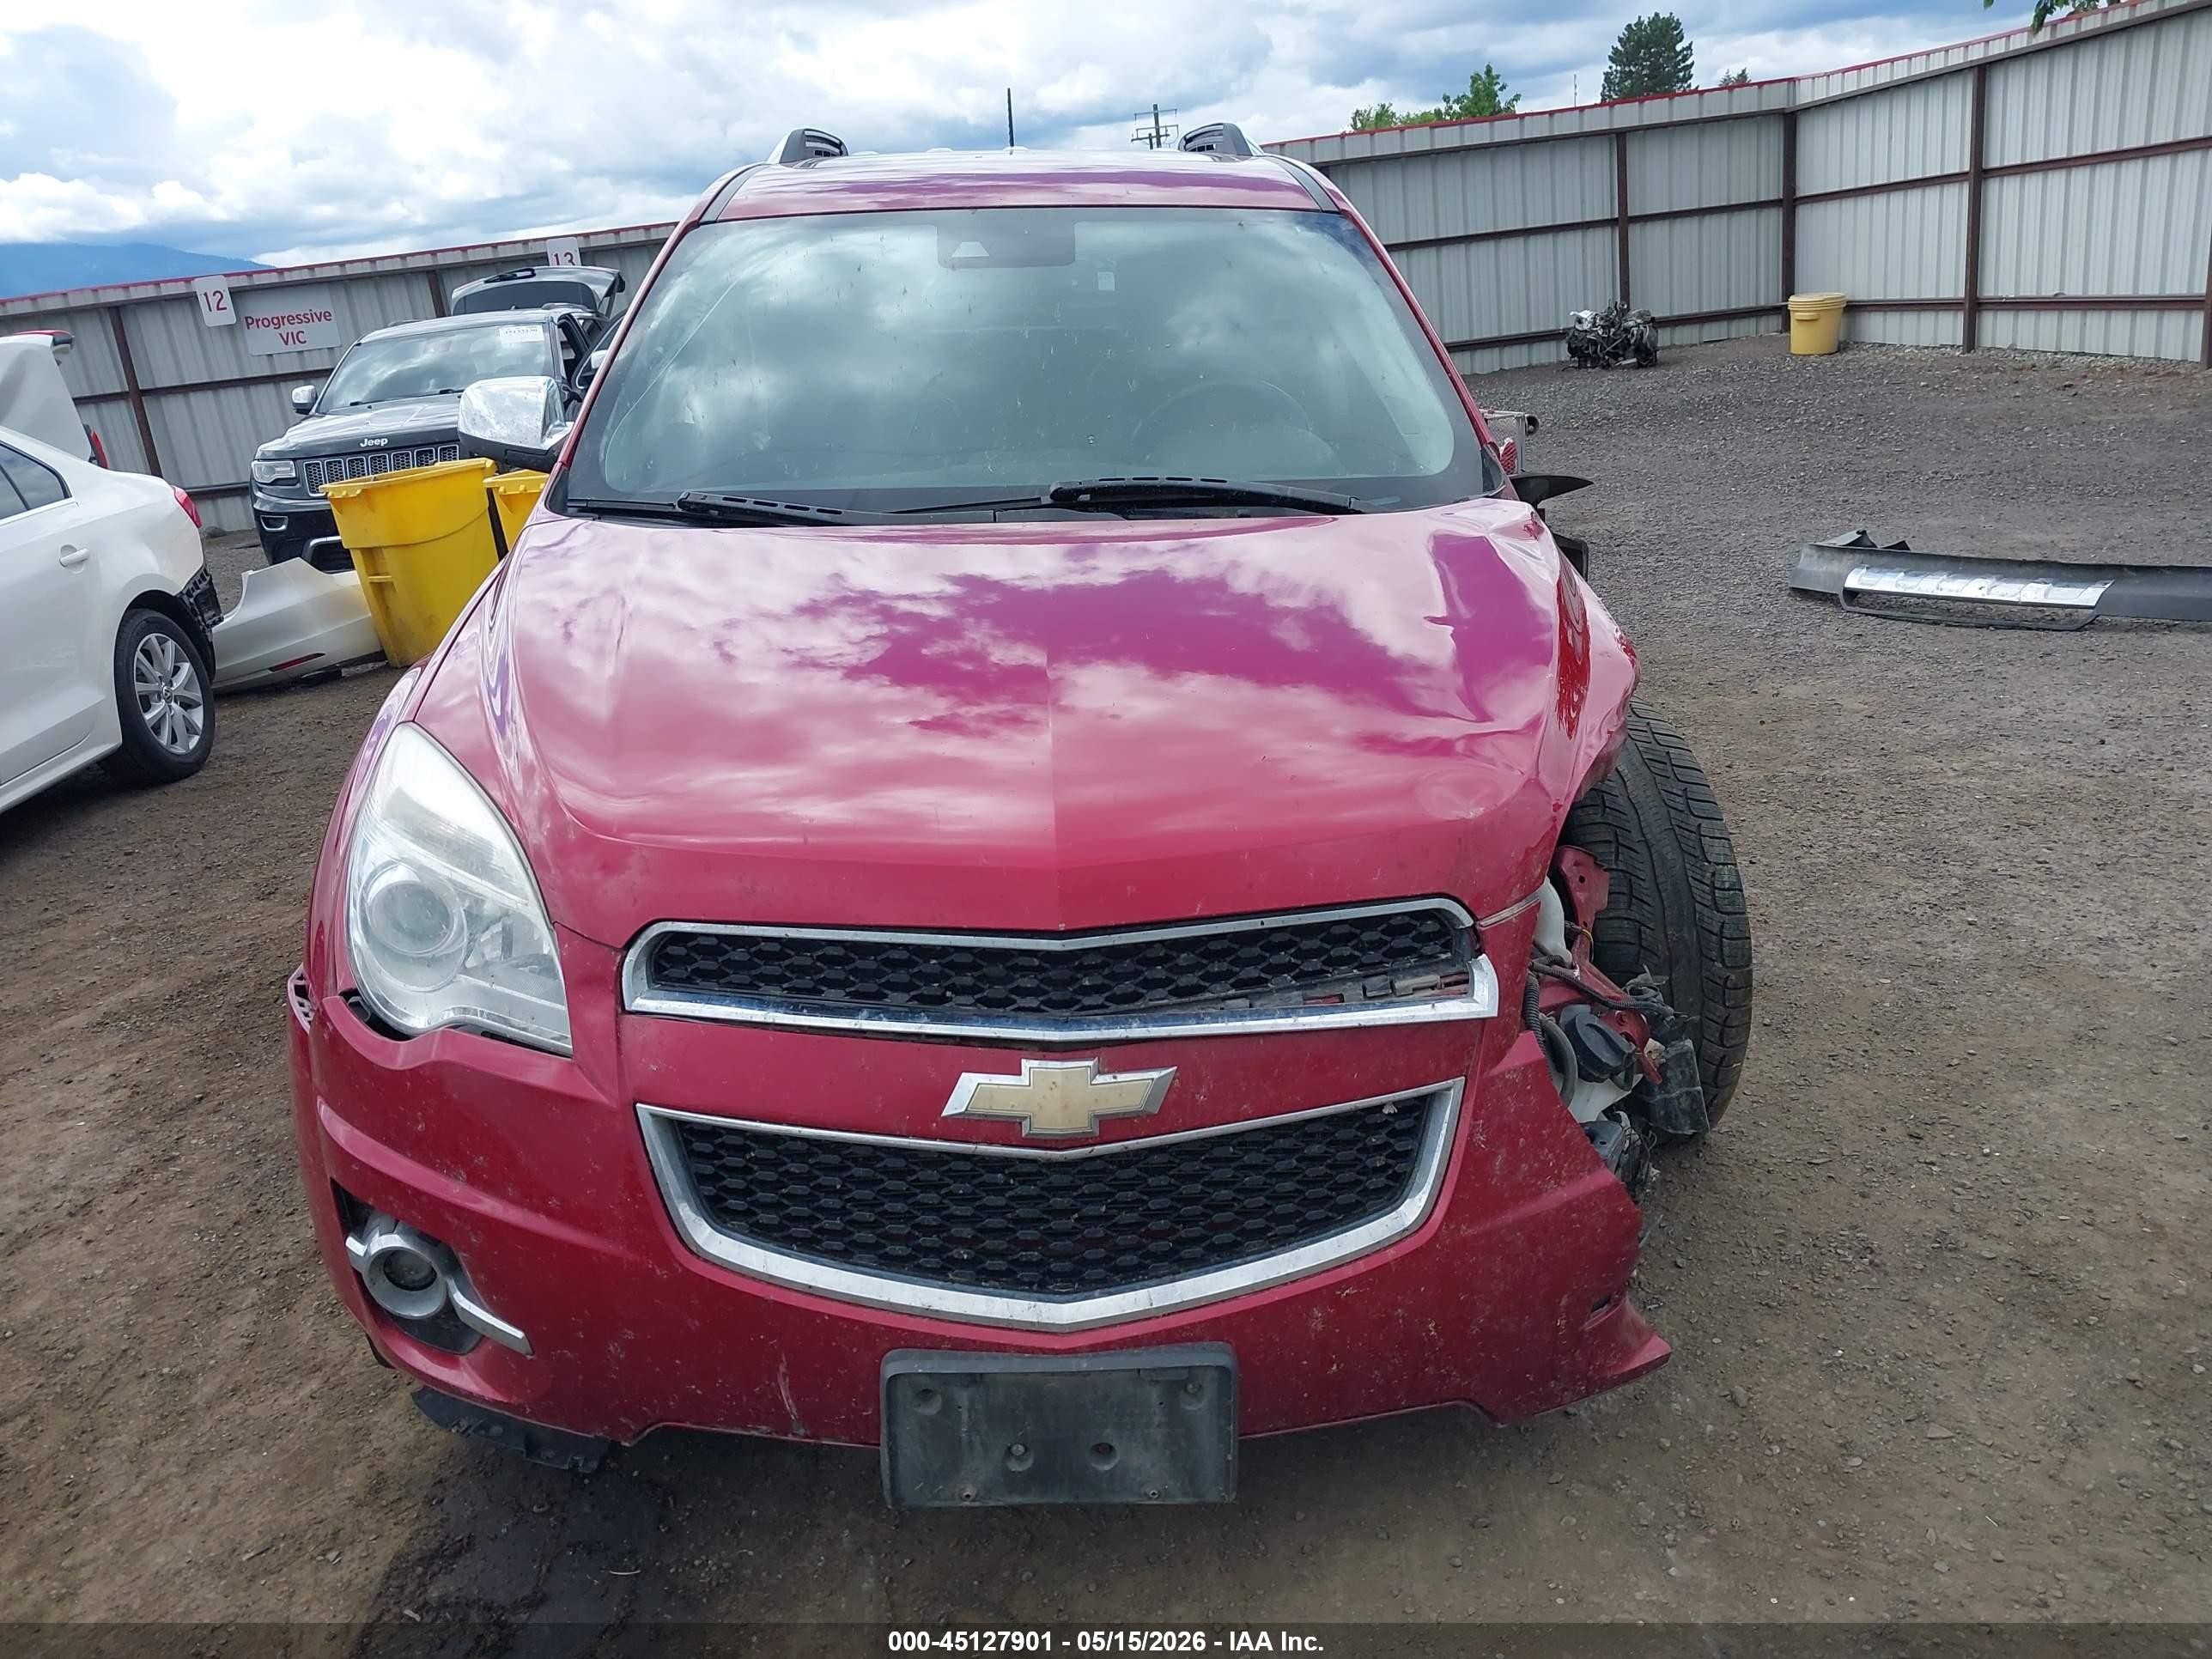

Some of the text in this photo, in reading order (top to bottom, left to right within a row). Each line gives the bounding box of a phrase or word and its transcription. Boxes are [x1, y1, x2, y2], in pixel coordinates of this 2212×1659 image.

[203, 290, 228, 313] 12
[245, 309, 332, 330] Progressive
[279, 331, 307, 346] VIC
[360, 438, 388, 447] Jeep
